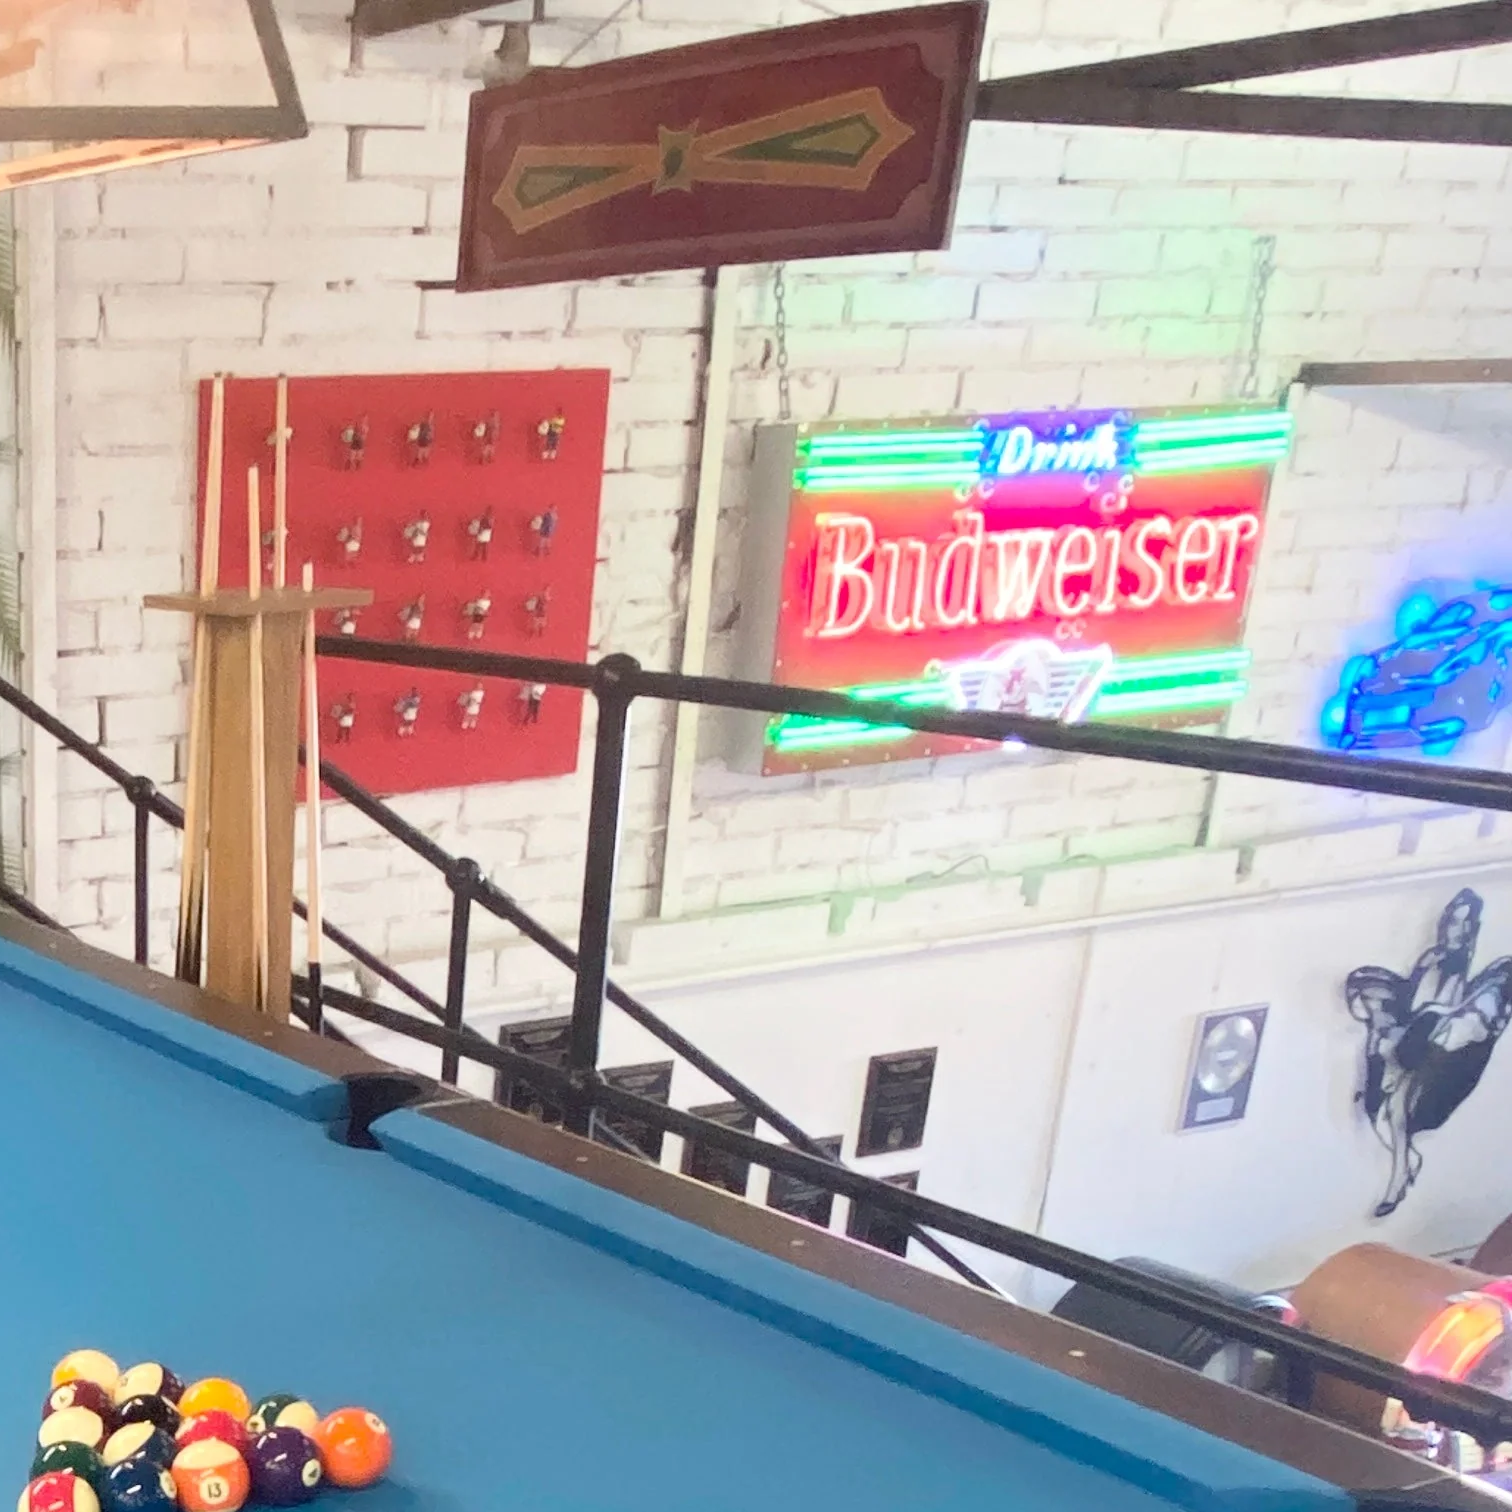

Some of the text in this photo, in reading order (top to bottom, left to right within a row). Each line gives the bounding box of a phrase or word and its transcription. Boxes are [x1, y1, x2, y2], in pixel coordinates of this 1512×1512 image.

[996, 424, 1119, 475] Drink
[808, 511, 1258, 639] Budweiser
[207, 1482, 222, 1499] 13
